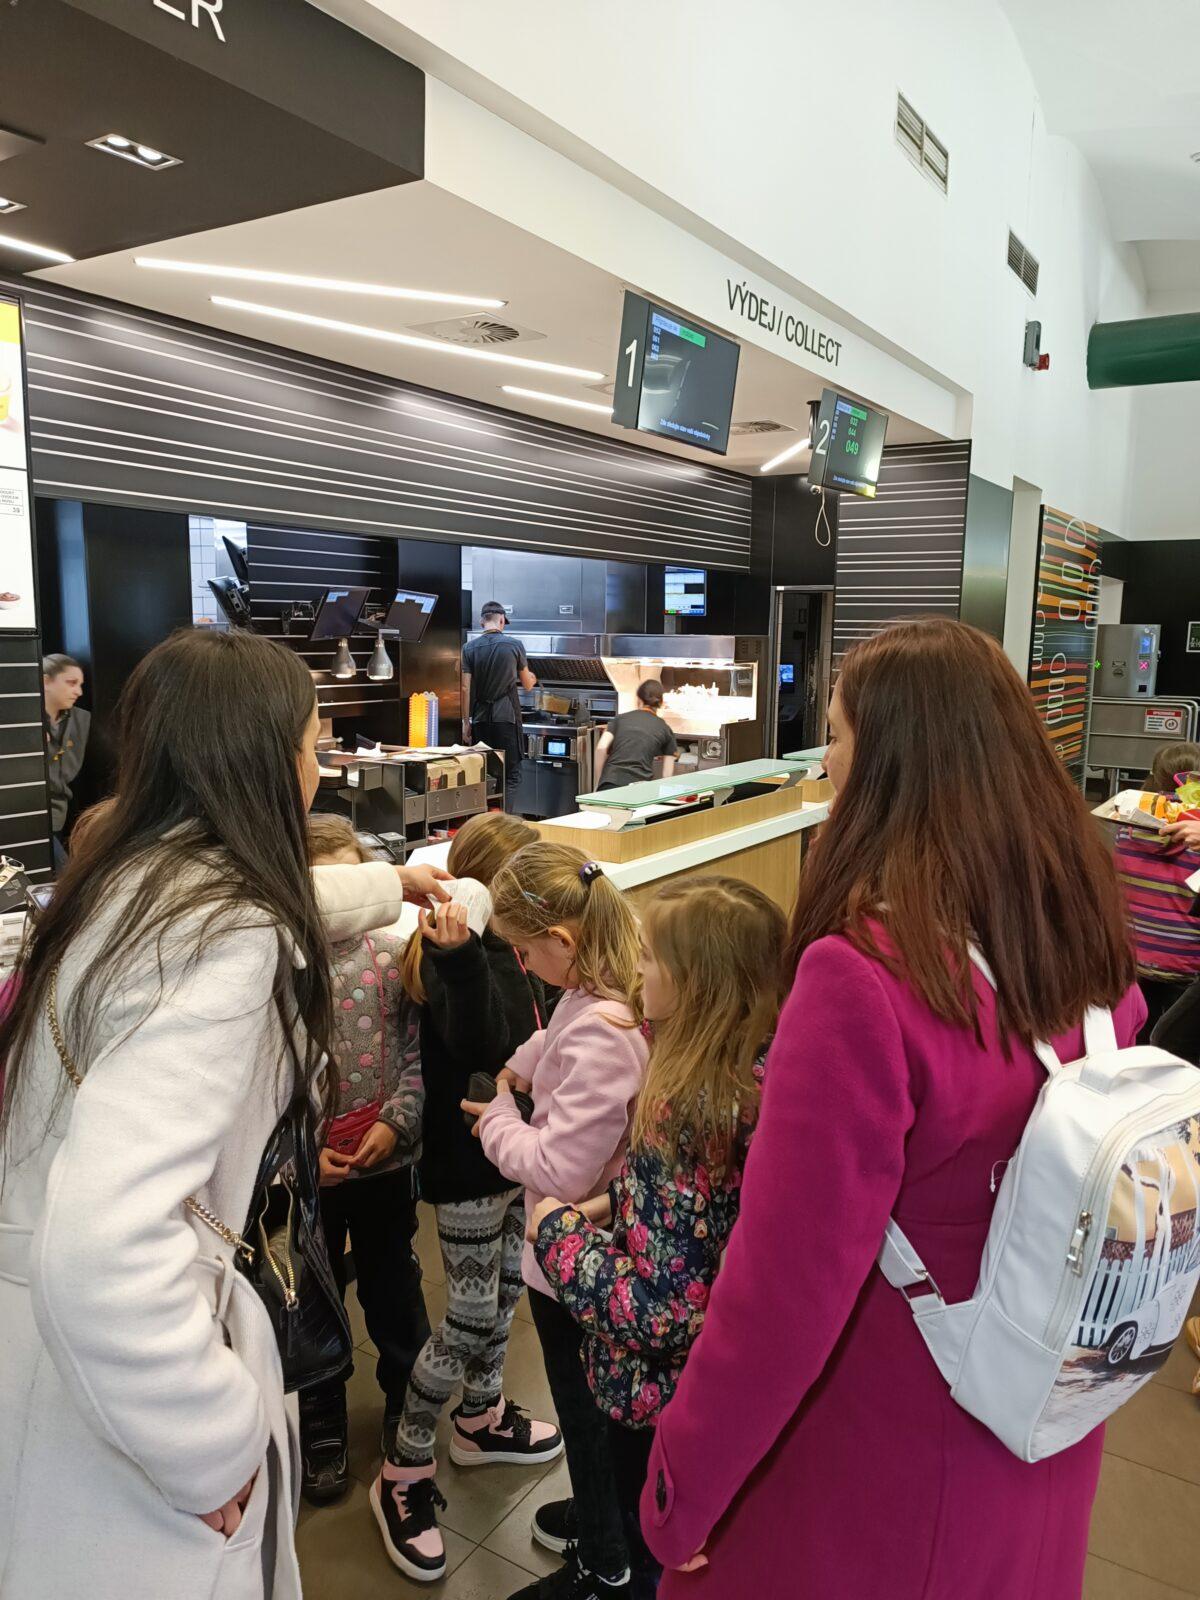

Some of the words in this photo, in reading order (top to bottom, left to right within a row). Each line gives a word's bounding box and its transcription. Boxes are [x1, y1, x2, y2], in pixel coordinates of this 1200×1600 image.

[727, 278, 776, 332] VÝDEJ
[776, 310, 784, 336] /
[785, 315, 842, 367] COLLECT
[625, 339, 638, 388] 1
[815, 419, 830, 456] 2
[845, 440, 859, 456] 049
